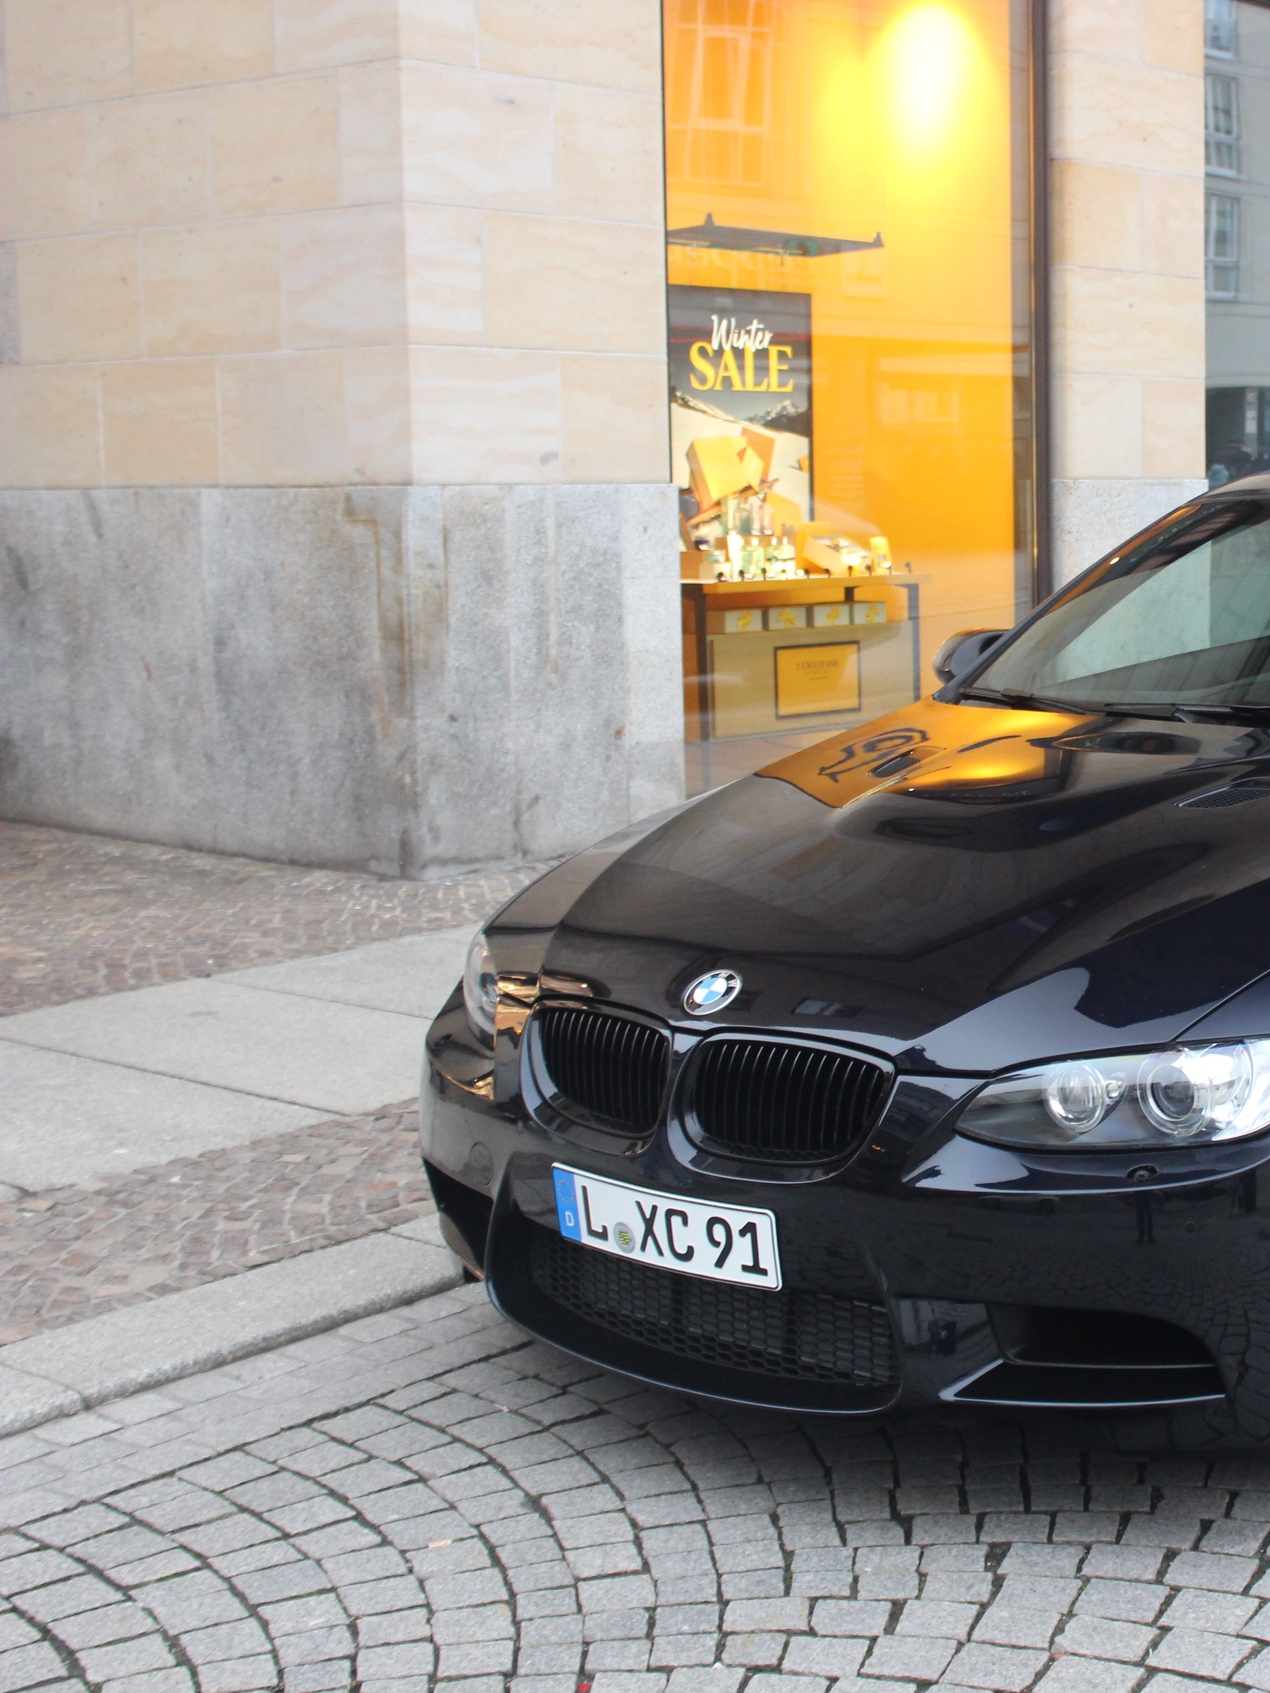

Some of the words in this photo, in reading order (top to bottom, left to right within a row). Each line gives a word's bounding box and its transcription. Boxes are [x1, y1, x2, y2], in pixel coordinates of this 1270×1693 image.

[711, 314, 773, 352] Winter
[689, 340, 793, 392] SALE
[565, 1211, 574, 1227] D
[581, 1185, 608, 1241] L
[635, 1200, 694, 1262] XC
[706, 1216, 768, 1276] 91
